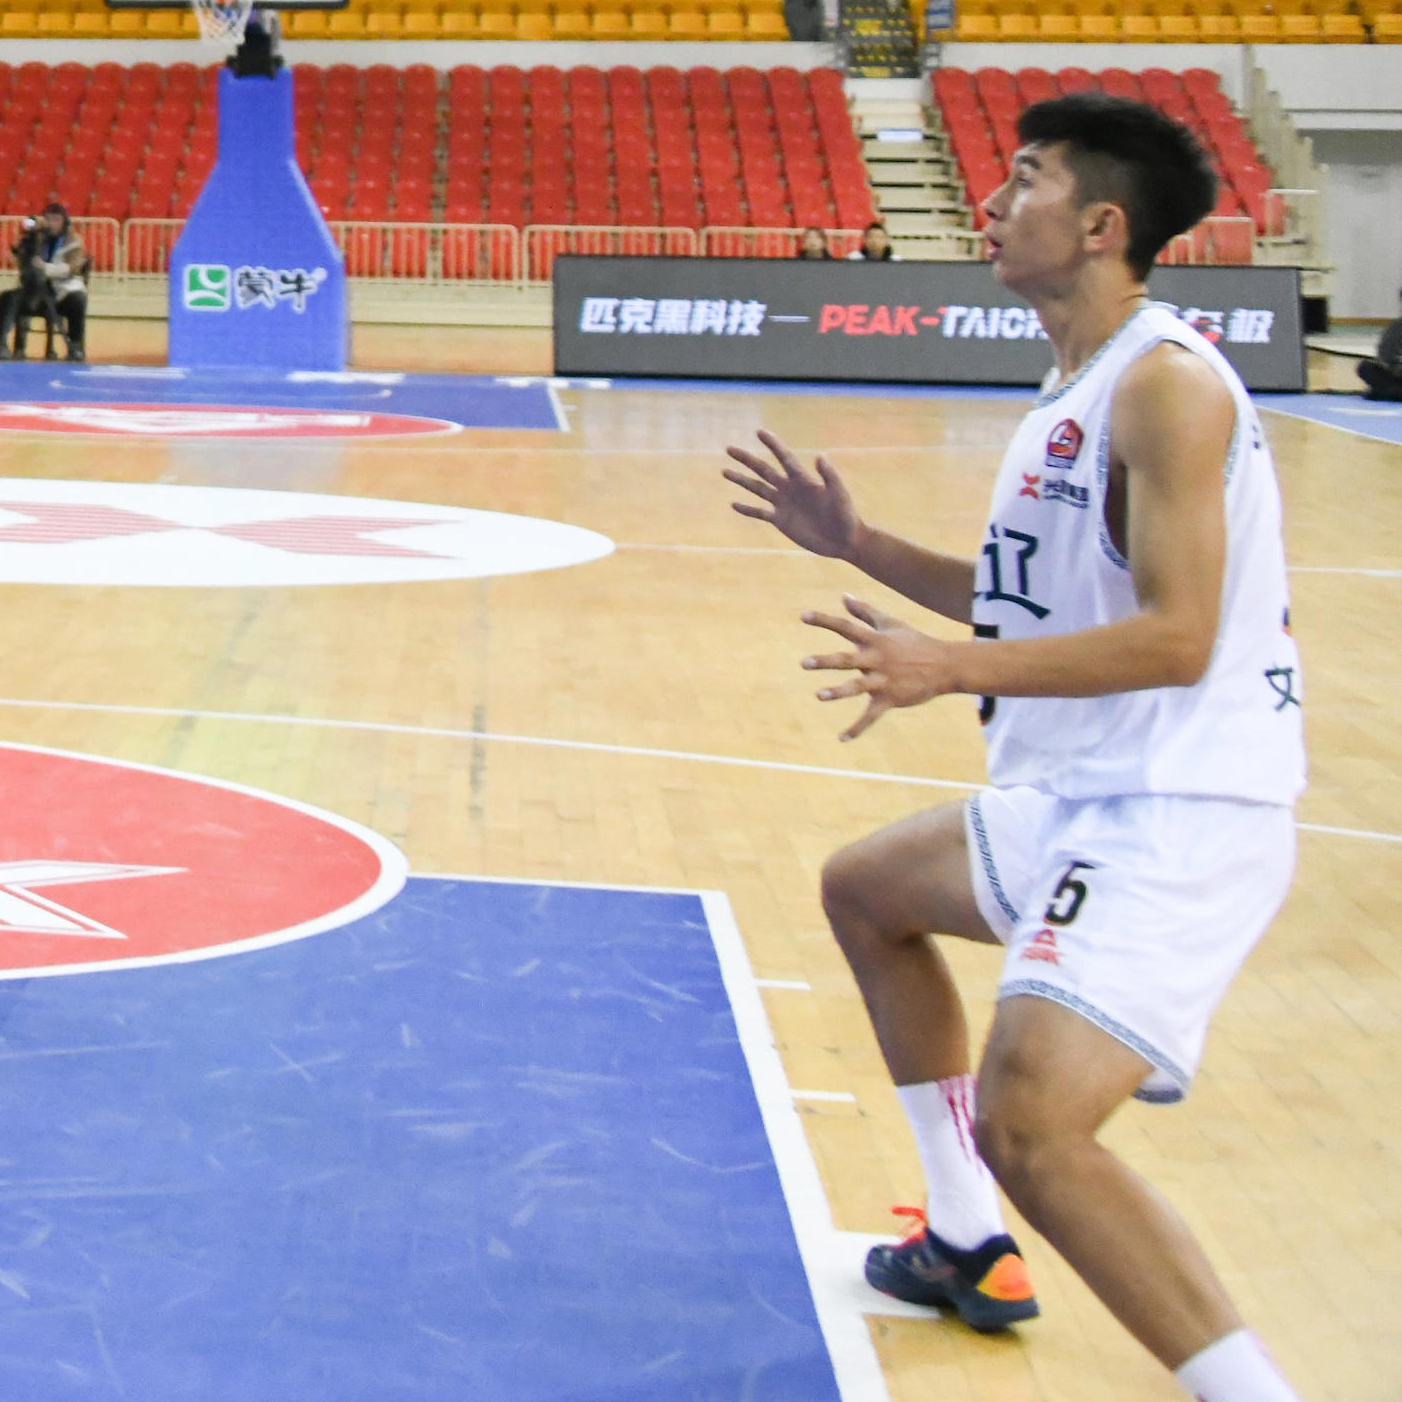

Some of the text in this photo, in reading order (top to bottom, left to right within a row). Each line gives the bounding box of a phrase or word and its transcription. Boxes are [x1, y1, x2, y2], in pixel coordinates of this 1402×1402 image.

[235, 266, 327, 312] 蒙牛
[577, 296, 767, 338] 匹克黑科技
[817, 302, 1054, 341] PEAK-TAICH
[973, 522, 1051, 620] 辽
[1043, 860, 1095, 927] 5
